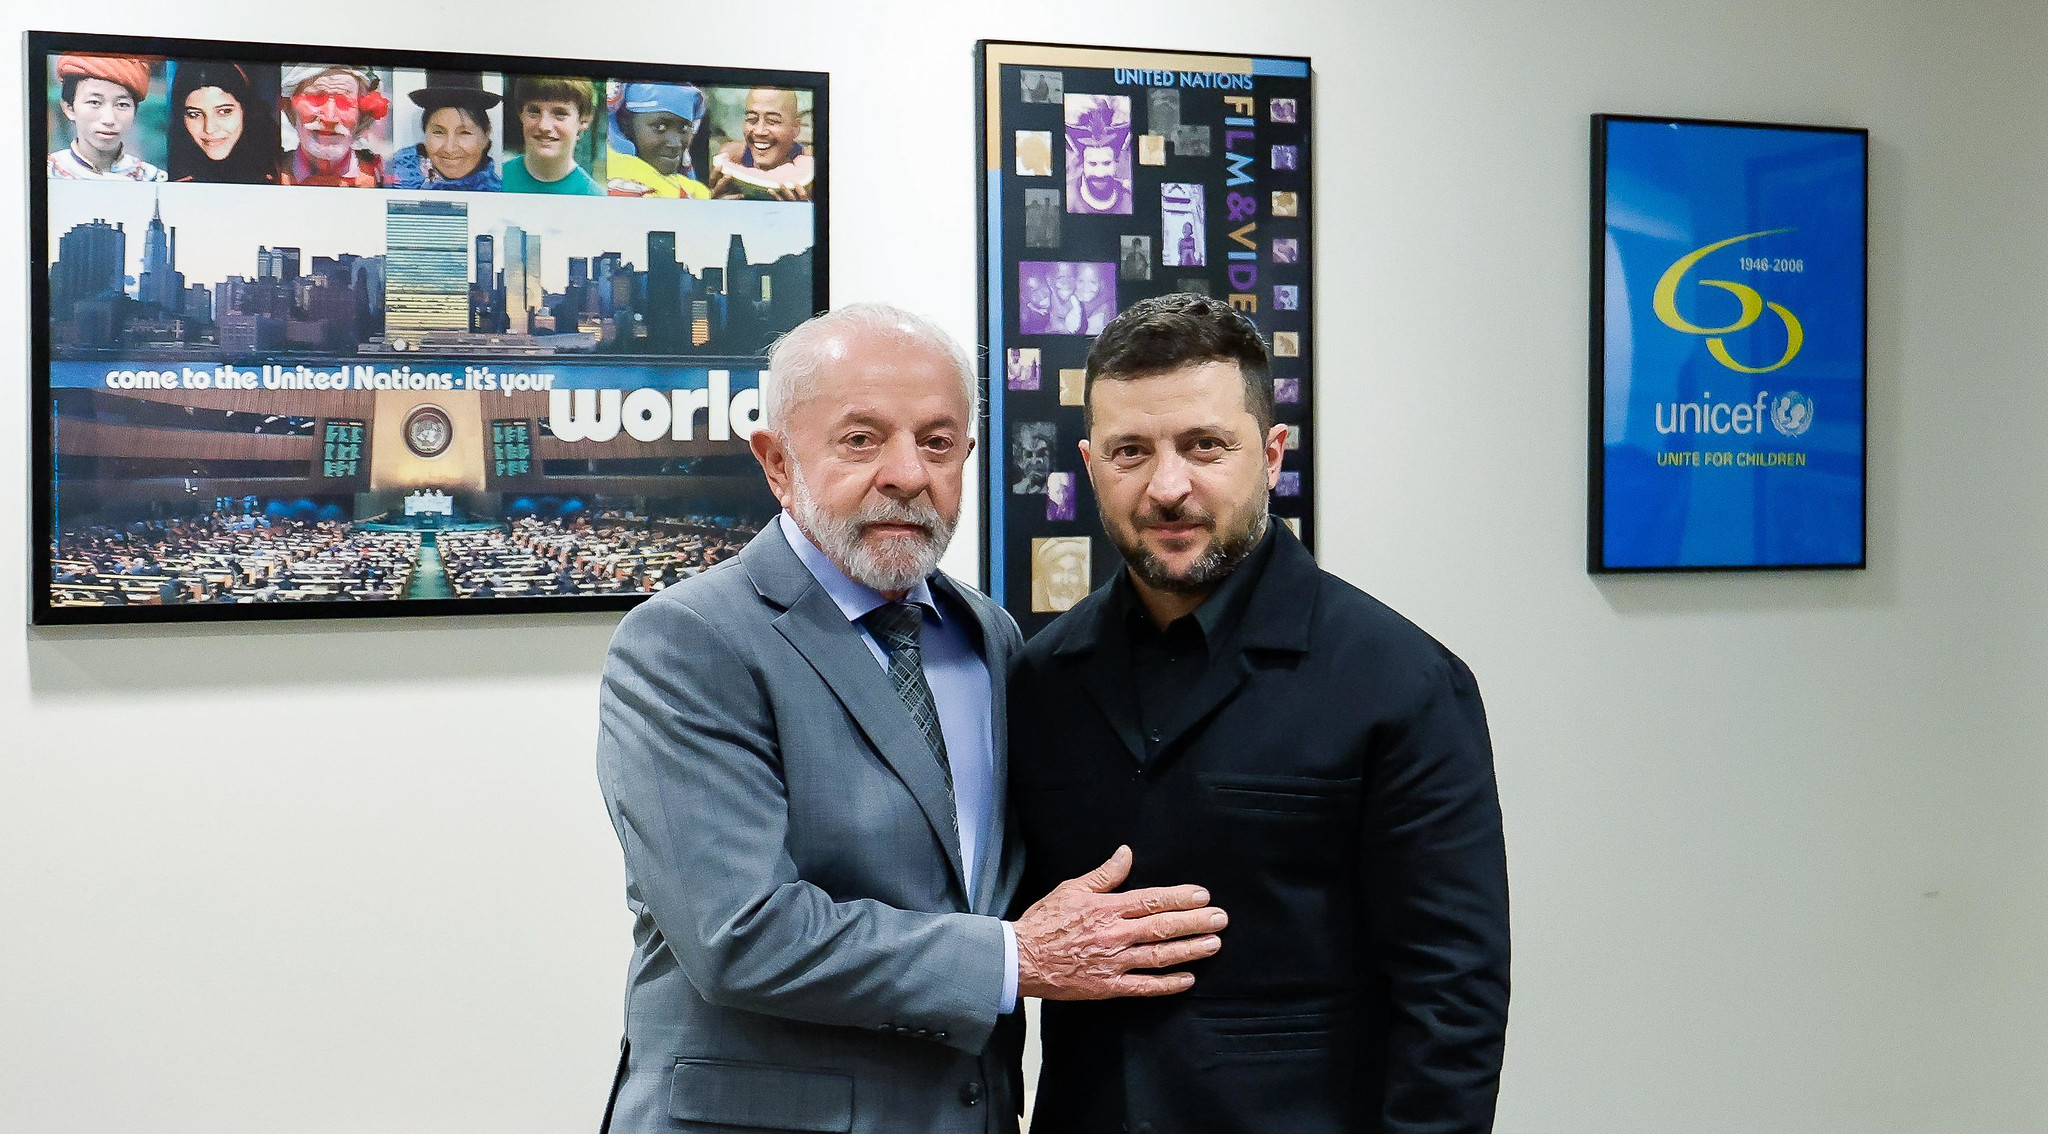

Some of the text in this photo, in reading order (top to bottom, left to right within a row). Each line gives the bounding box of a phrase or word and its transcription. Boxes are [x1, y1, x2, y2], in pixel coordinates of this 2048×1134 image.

[1114, 68, 1254, 90] UNITED NATIONS
[1224, 95, 1258, 316] FILM & VIDE
[1739, 257, 1804, 273] 1946-2006
[105, 370, 179, 390] come
[182, 367, 211, 390] to
[214, 364, 259, 390] the
[262, 365, 350, 391] United
[499, 373, 555, 397] your
[549, 369, 772, 443] world
[1655, 390, 1769, 435] unicef
[1657, 451, 1806, 467] UNITE FOR CHILDREN
